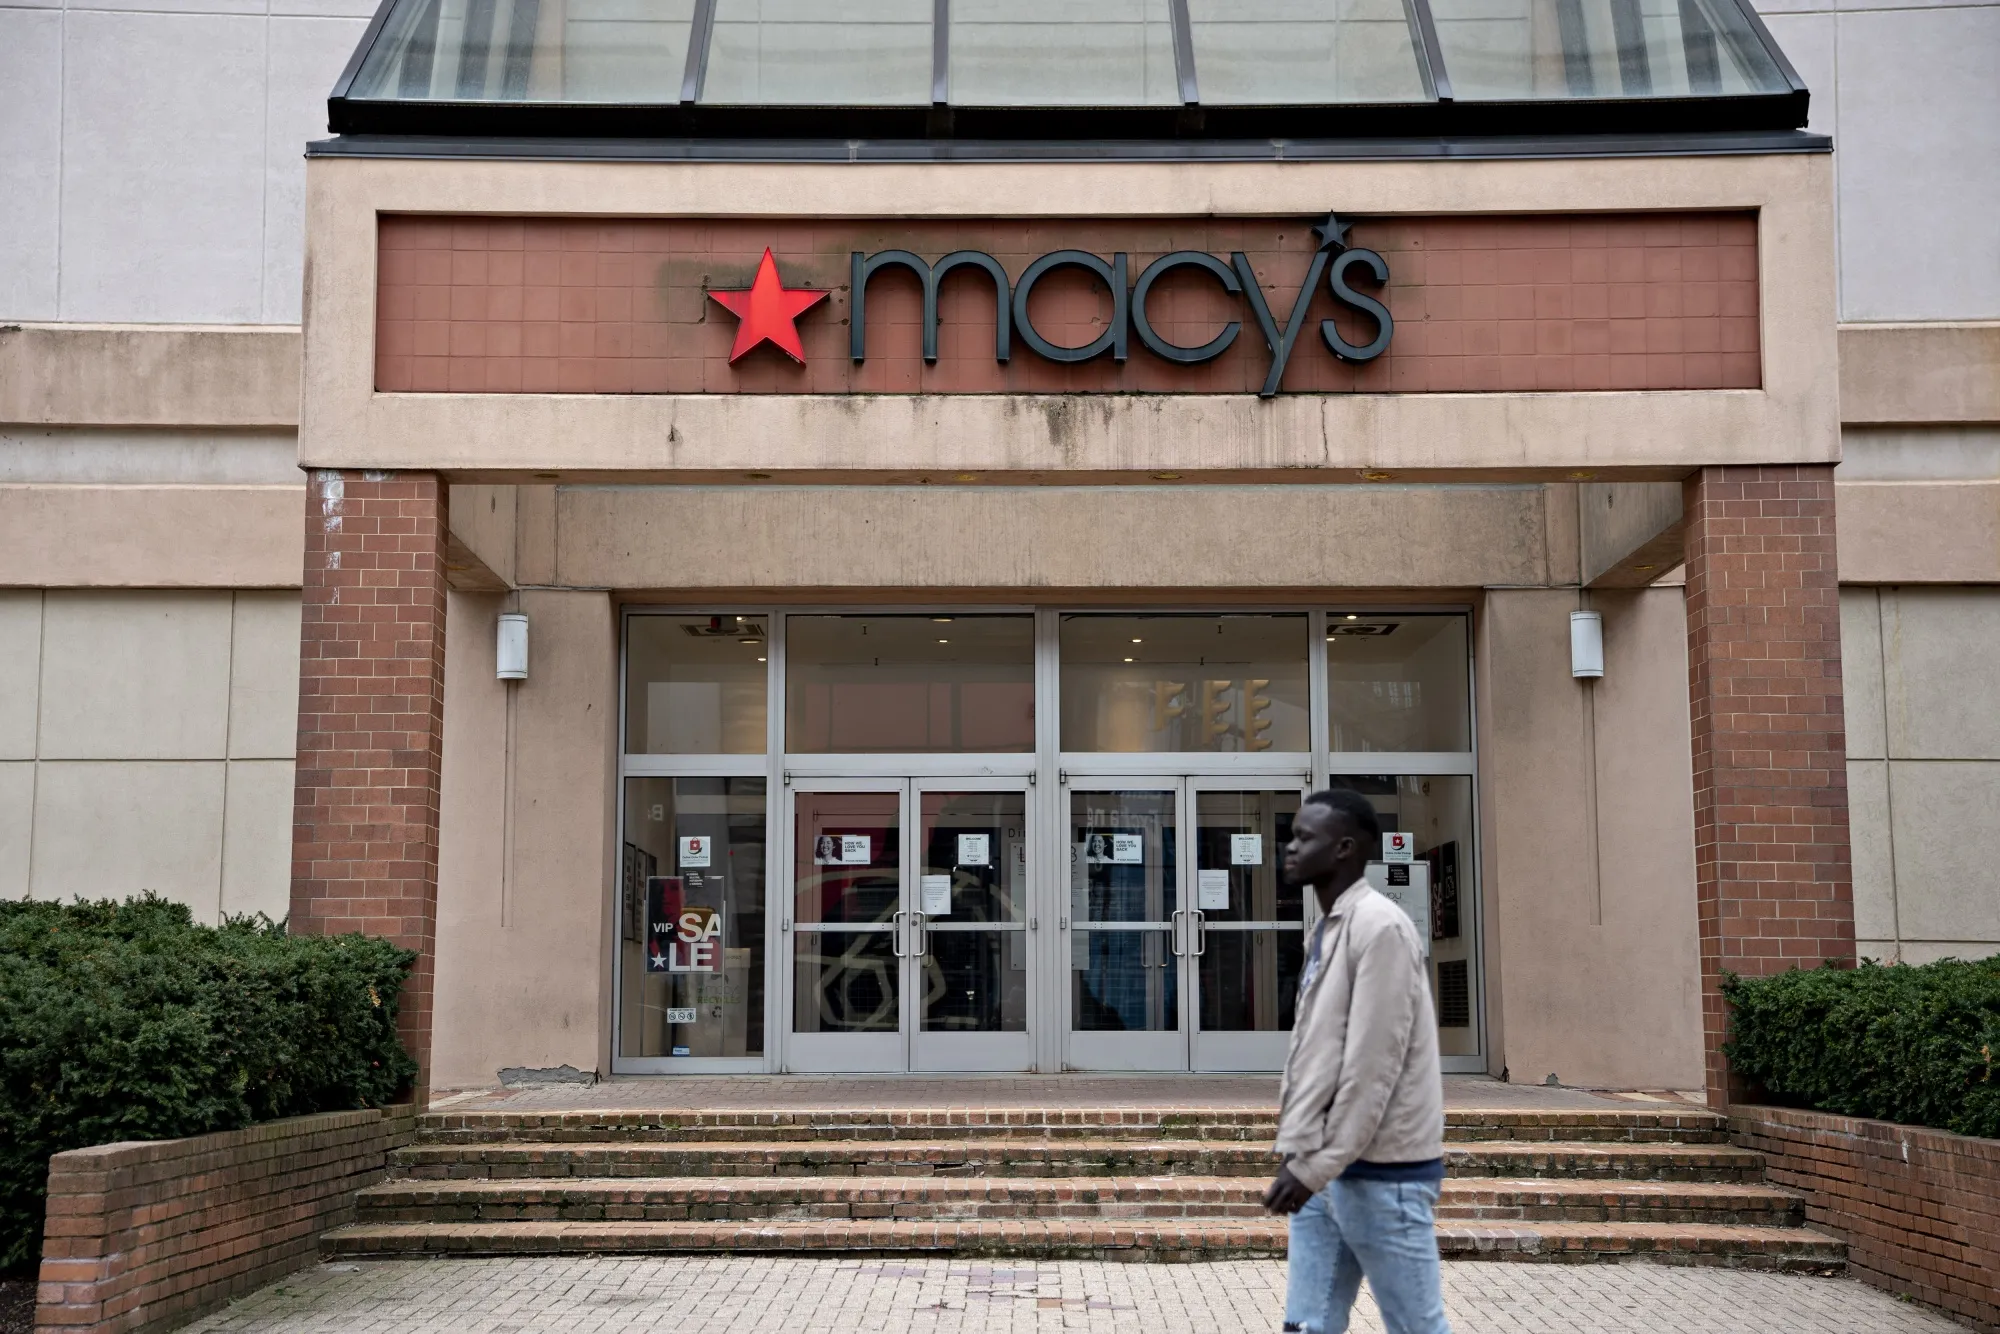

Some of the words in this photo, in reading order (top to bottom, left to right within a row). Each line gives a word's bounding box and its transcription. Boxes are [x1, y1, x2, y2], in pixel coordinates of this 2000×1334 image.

[850, 210, 1394, 397] macy's
[653, 922, 674, 934] VIP
[678, 913, 721, 943] SA
[669, 943, 714, 972] LE
